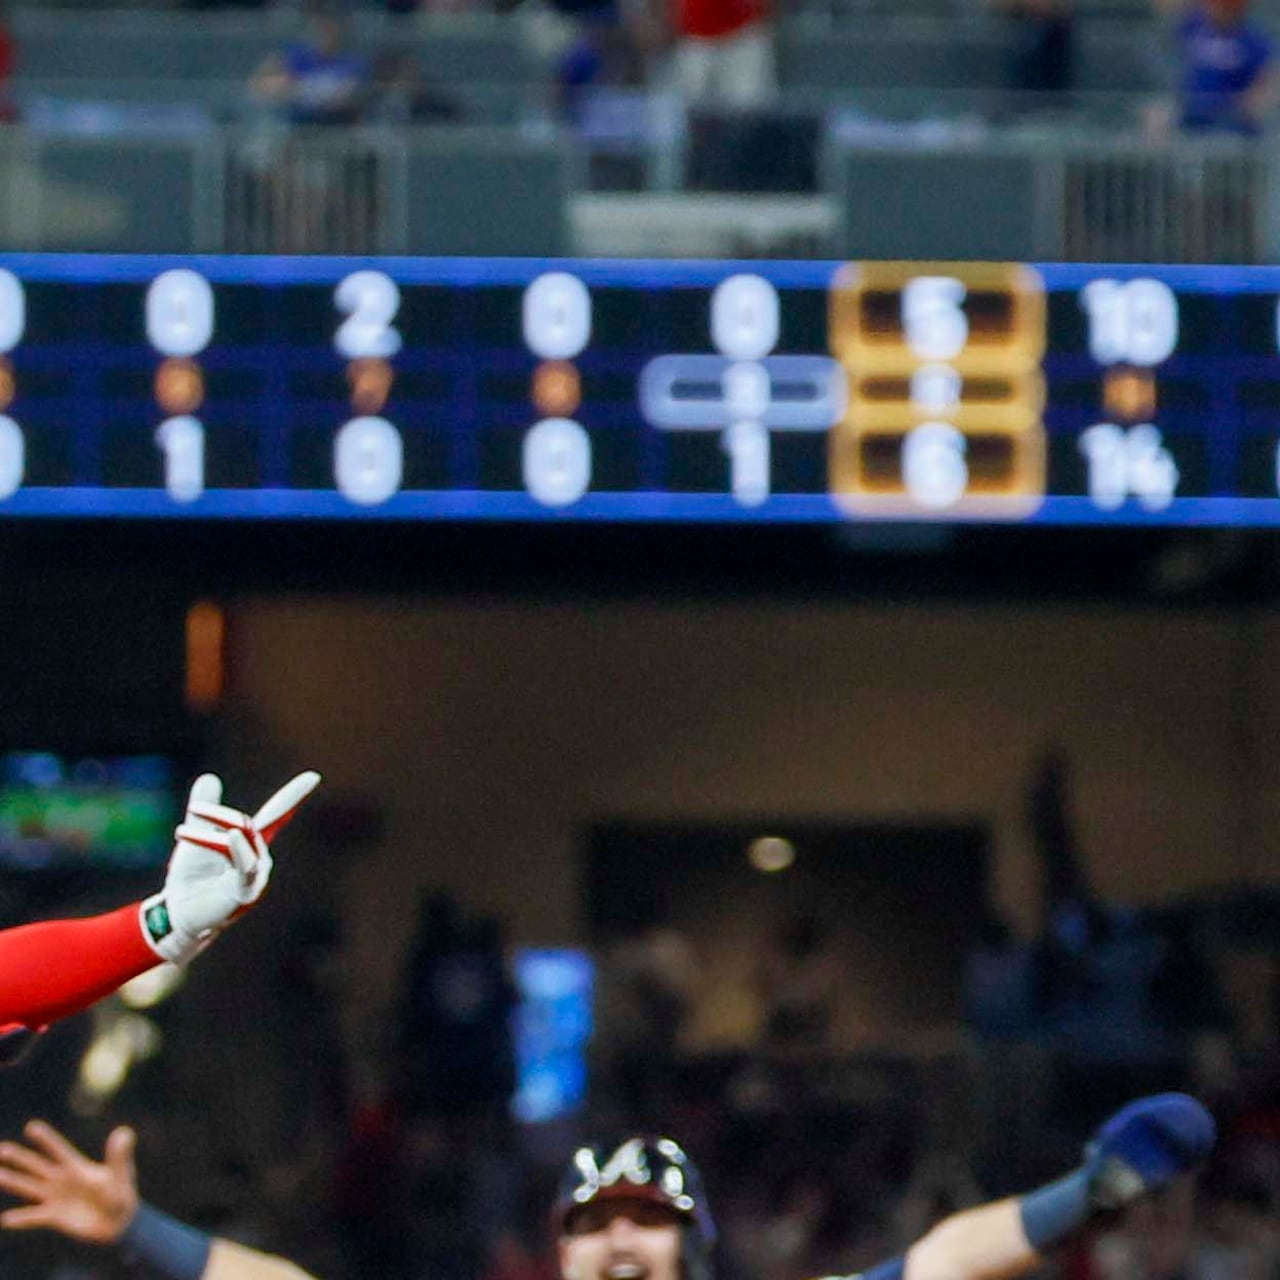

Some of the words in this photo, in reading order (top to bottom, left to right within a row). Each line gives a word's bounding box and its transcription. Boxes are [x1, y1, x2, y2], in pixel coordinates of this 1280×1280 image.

[146, 269, 214, 357] 0
[334, 270, 401, 360] 2
[523, 271, 592, 360] 0
[711, 273, 779, 361] 0
[1082, 277, 1179, 366] 10
[156, 415, 204, 501] 1
[333, 415, 403, 504] 0
[522, 416, 592, 506] 0
[722, 418, 770, 507] 1
[1081, 423, 1180, 511] 14
